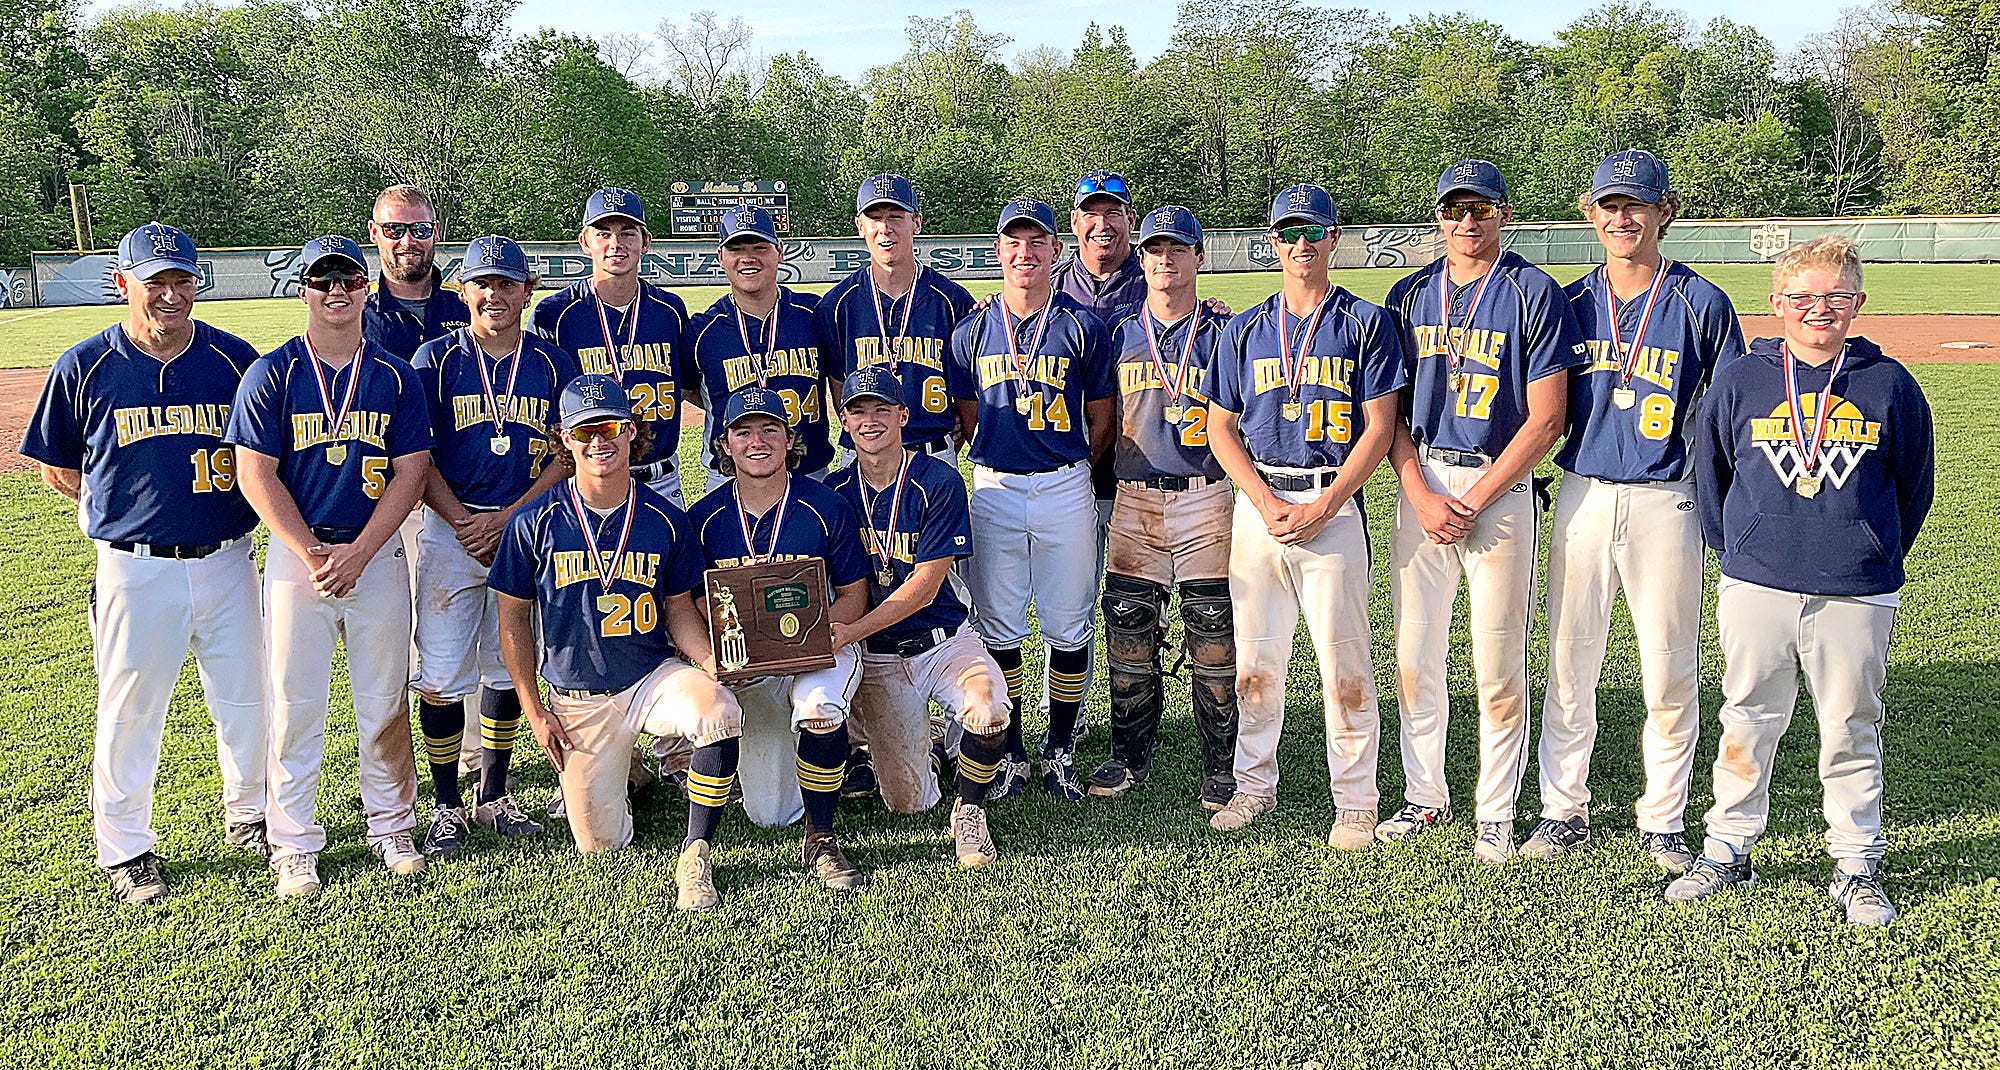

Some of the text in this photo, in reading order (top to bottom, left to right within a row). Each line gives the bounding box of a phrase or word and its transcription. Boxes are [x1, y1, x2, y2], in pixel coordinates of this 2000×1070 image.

[701, 181, 739, 193] Medina
[1753, 234, 1785, 250] 365
[855, 335, 944, 373] HILLSDALE
[630, 380, 676, 422] 25
[922, 375, 948, 414] 6
[1028, 391, 1072, 432] 14
[1456, 372, 1500, 420] 17
[1304, 399, 1353, 444] 15
[1638, 392, 1676, 441] 8
[190, 447, 238, 494] 19
[361, 455, 389, 500] 5
[528, 437, 549, 479] 7
[600, 592, 658, 638] 20
